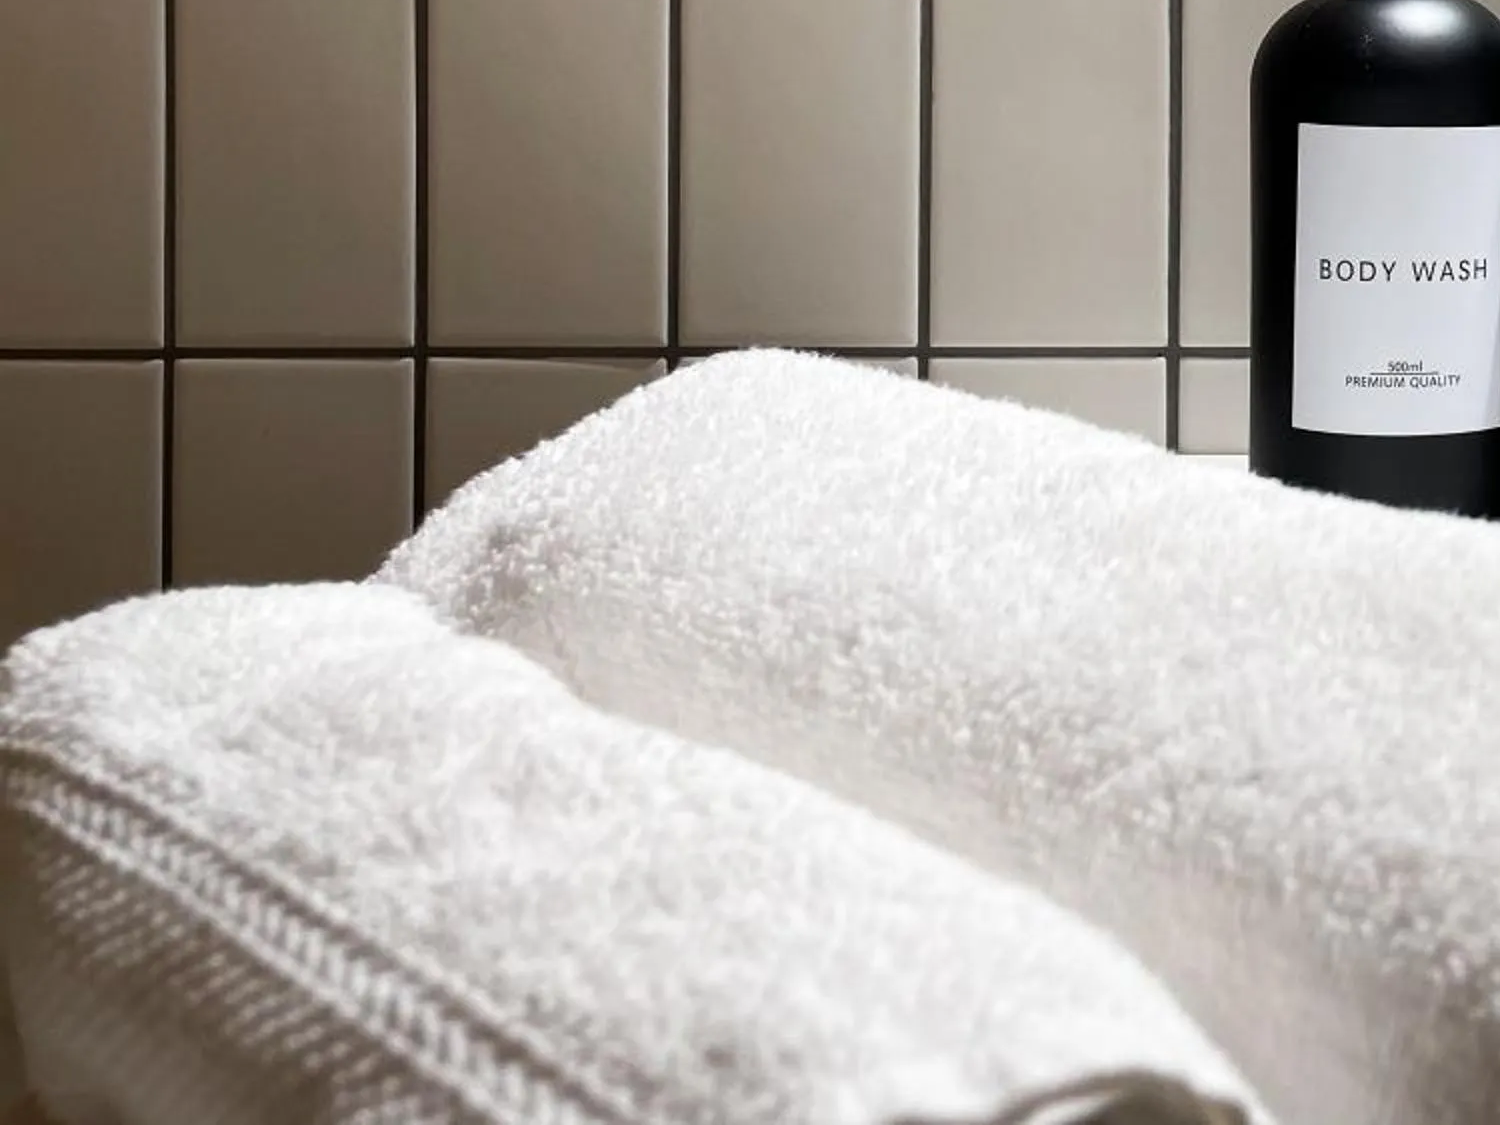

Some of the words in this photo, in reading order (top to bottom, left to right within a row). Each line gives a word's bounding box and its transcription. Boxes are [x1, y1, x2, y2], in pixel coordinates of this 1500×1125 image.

[1319, 258, 1397, 282] BODY
[1411, 258, 1488, 282] WASH
[1387, 359, 1423, 372] 500ml
[1345, 375, 1406, 388] PREMIUM
[1409, 374, 1462, 389] QUALITY
